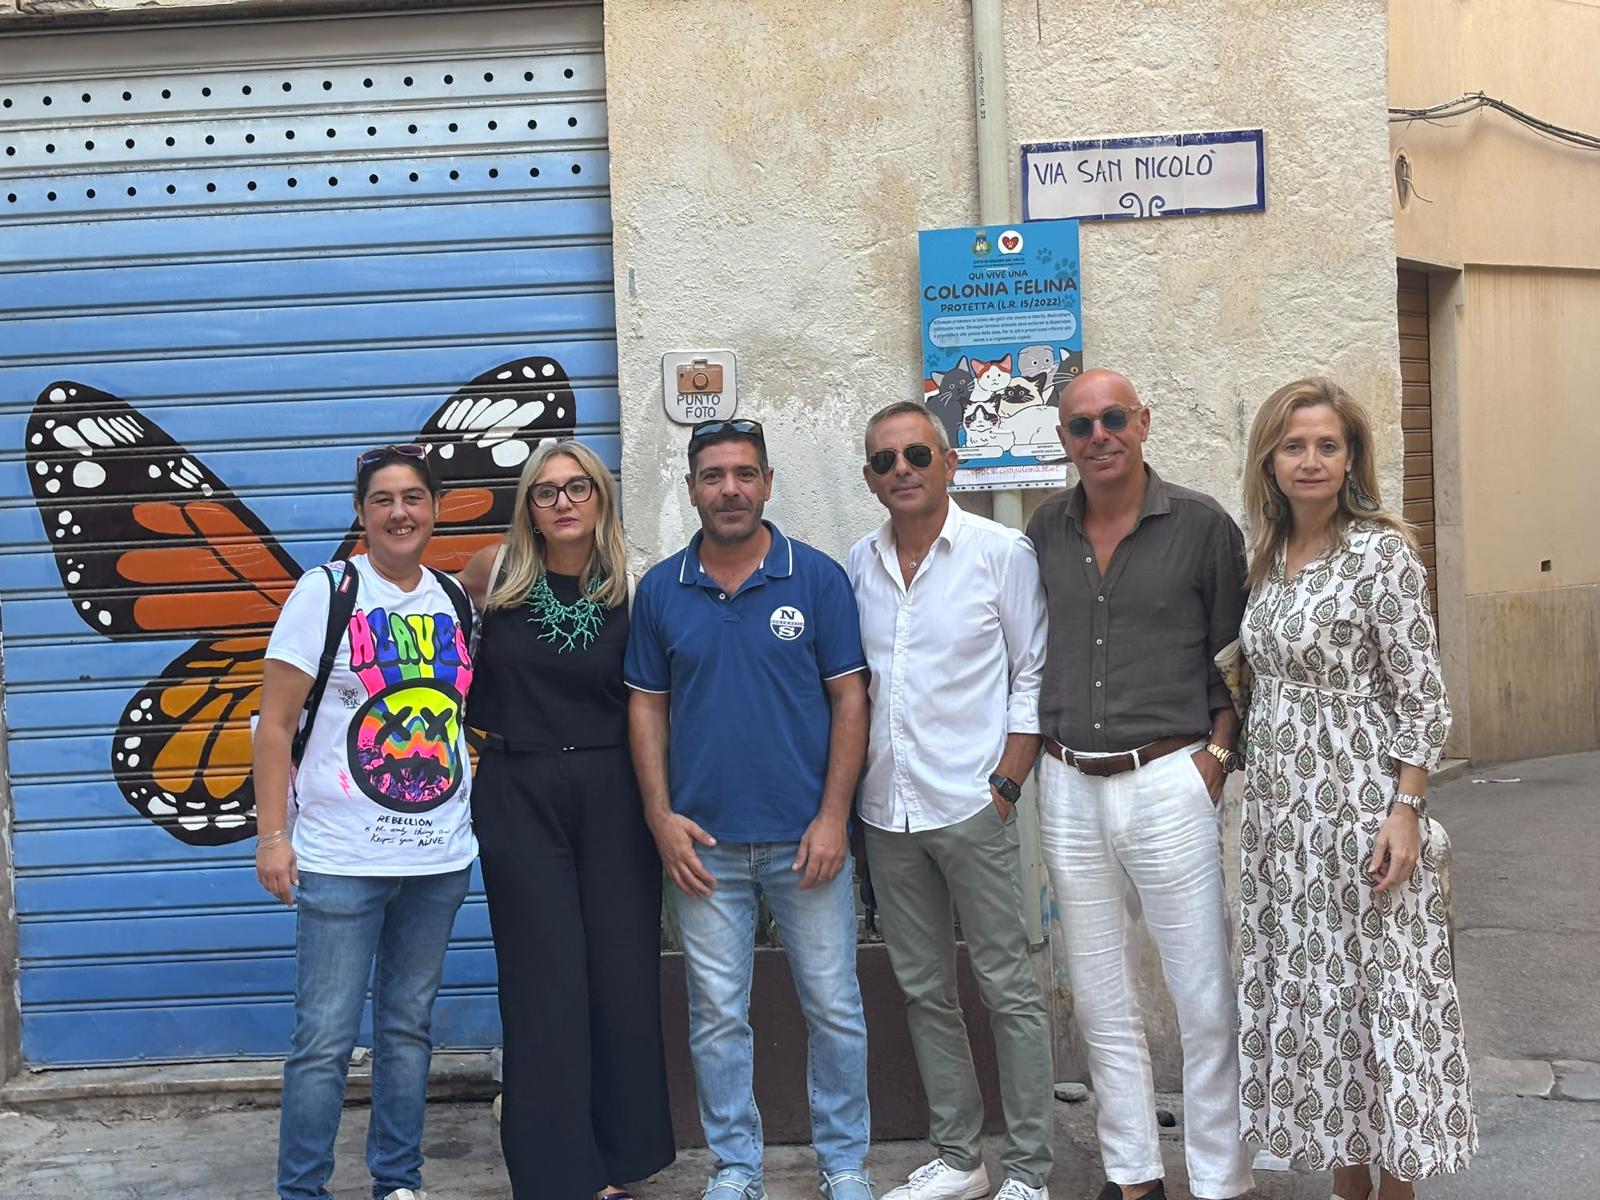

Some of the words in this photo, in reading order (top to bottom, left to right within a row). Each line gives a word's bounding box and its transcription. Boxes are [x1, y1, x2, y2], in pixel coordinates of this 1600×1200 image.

[1033, 162, 1067, 185] VIA
[1077, 159, 1122, 183] SAN
[1135, 149, 1216, 180] NICOLÒ
[968, 272, 983, 280] QUI
[986, 270, 1006, 279] VIVE
[1008, 269, 1028, 278] UNA
[924, 281, 1008, 301] COLONIA
[1014, 277, 1077, 296] FELINA
[940, 302, 995, 313] PROTETTA
[1020, 297, 1061, 308] 15/2022)
[676, 393, 721, 406] PUNTO
[685, 406, 716, 418] FOTO
[779, 609, 797, 620] N
[779, 626, 795, 637] S
[377, 814, 433, 827] REBELLION
[417, 836, 445, 847] ALIVE
